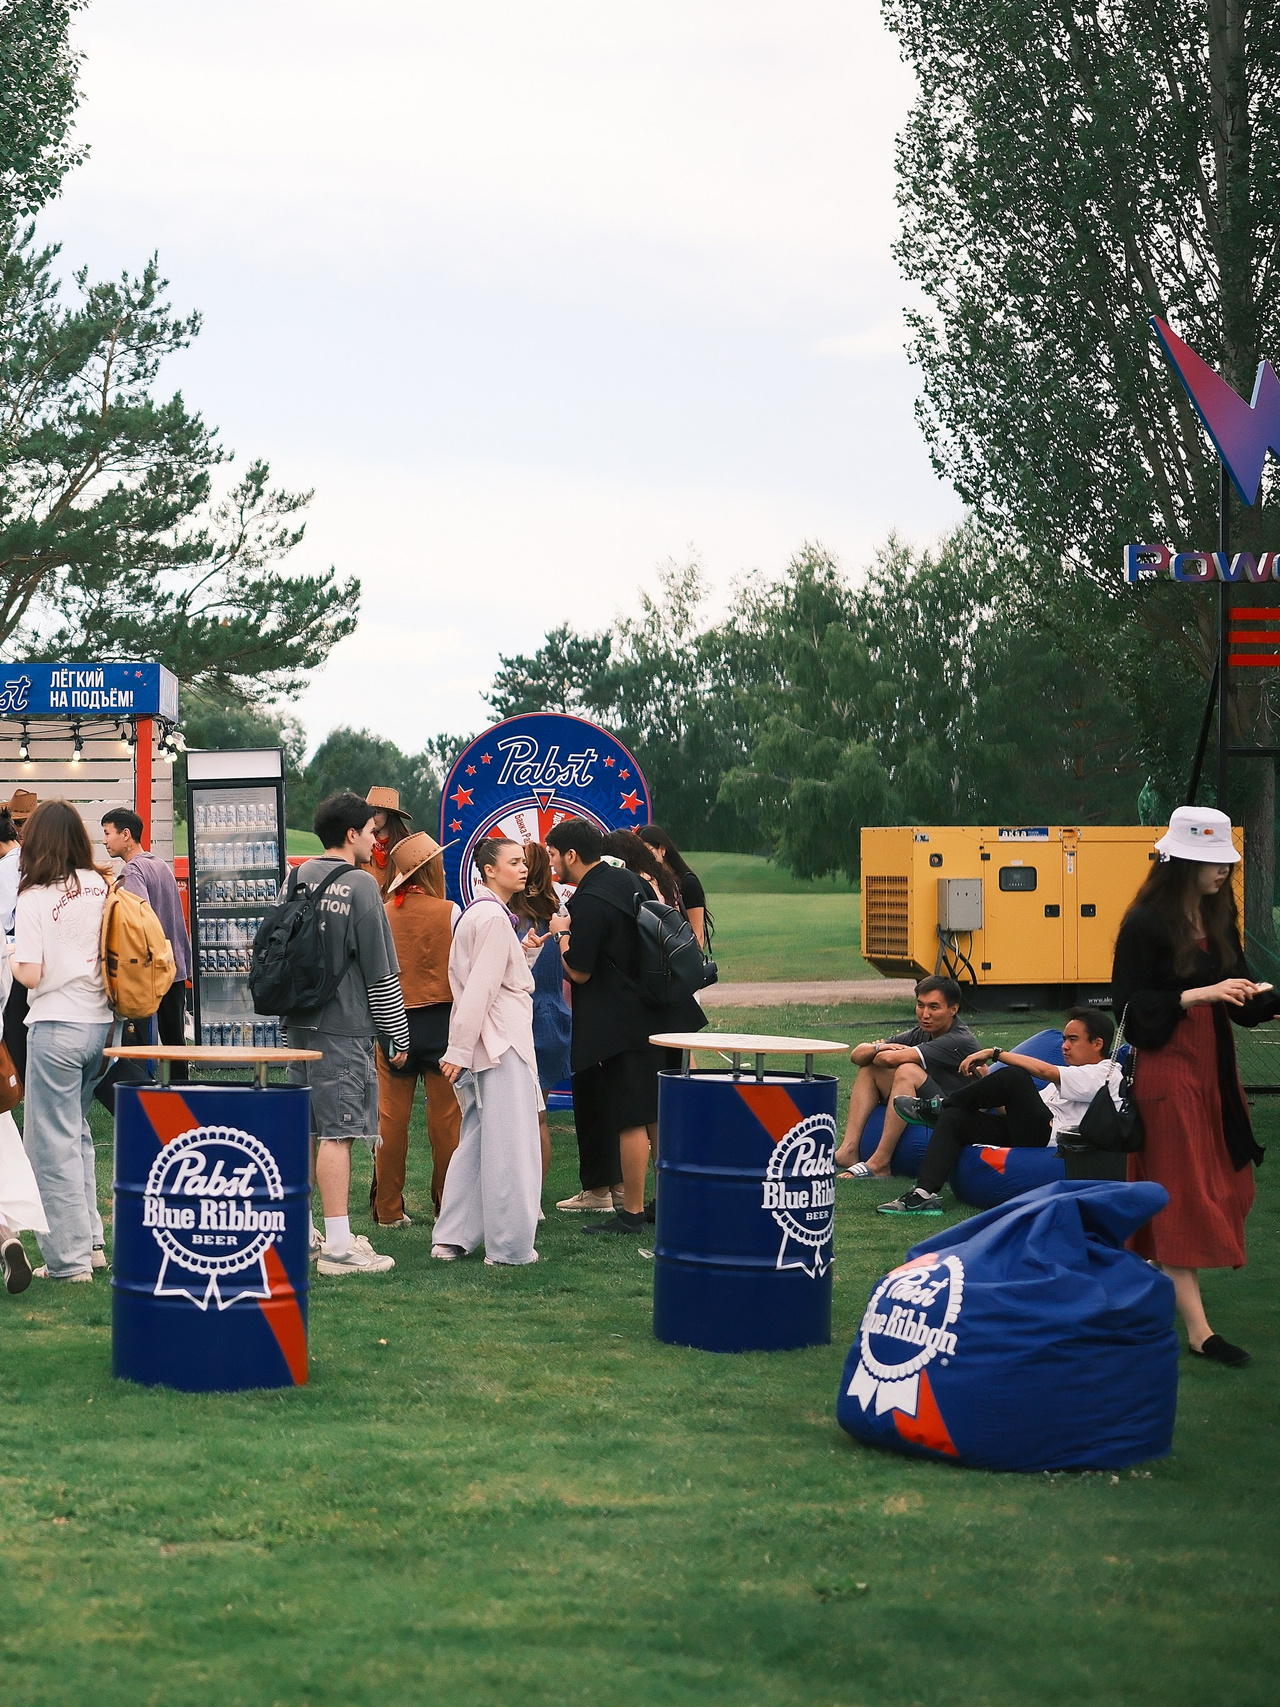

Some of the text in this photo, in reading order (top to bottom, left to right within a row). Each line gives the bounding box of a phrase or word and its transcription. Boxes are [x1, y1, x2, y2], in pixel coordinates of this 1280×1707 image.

[1124, 544, 1280, 583] Pow
[50, 667, 105, 688] ЛЁГКИЙ
[50, 688, 134, 710] НА ПОДЪЁМ!
[497, 735, 598, 787] Pabst
[514, 812, 528, 834] Банка
[169, 1150, 258, 1197] Pabst
[761, 1181, 809, 1209] Blue
[142, 1195, 286, 1232] Blue Ribbon
[806, 1210, 829, 1221] BEER
[192, 1234, 238, 1246] BEER
[883, 1305, 958, 1356] Ribbon
